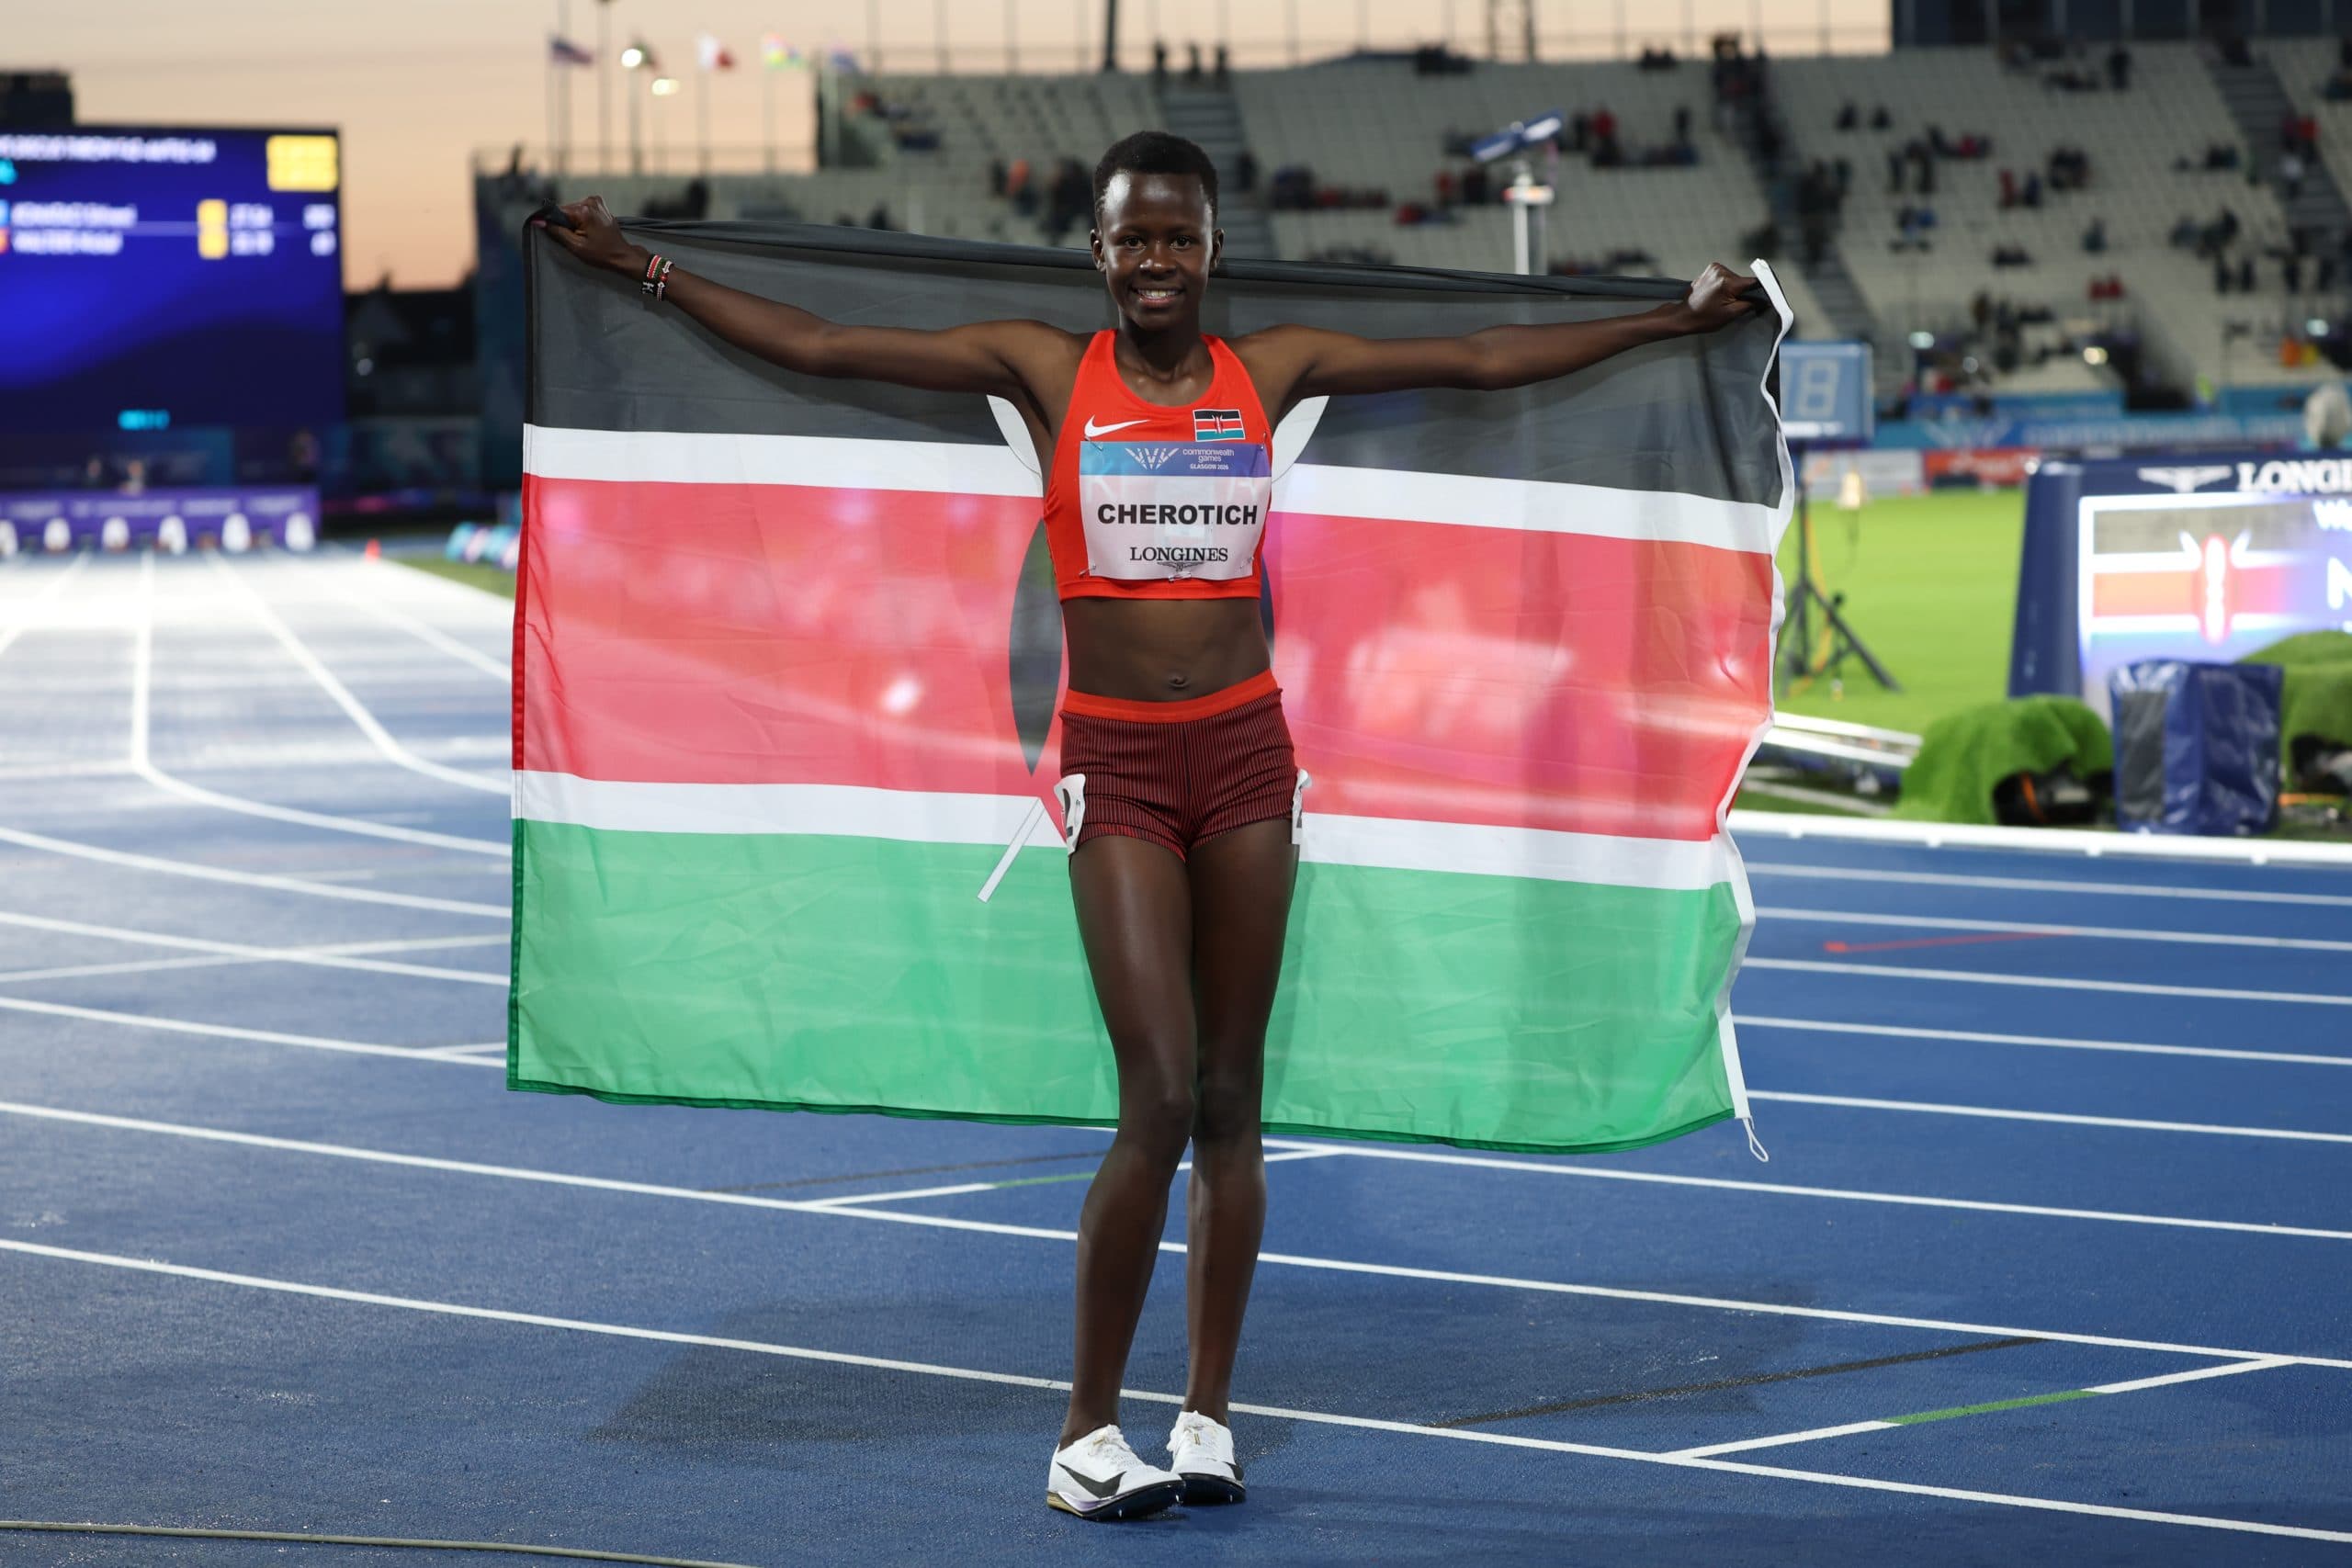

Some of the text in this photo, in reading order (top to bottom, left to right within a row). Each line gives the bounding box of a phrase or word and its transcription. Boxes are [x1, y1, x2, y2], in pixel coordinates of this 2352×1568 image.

[1182, 448, 1235, 457] commonwealth
[1198, 455, 1222, 464] games
[1098, 504, 1258, 525] CHEROTICH
[1130, 547, 1228, 562] LONGINES
